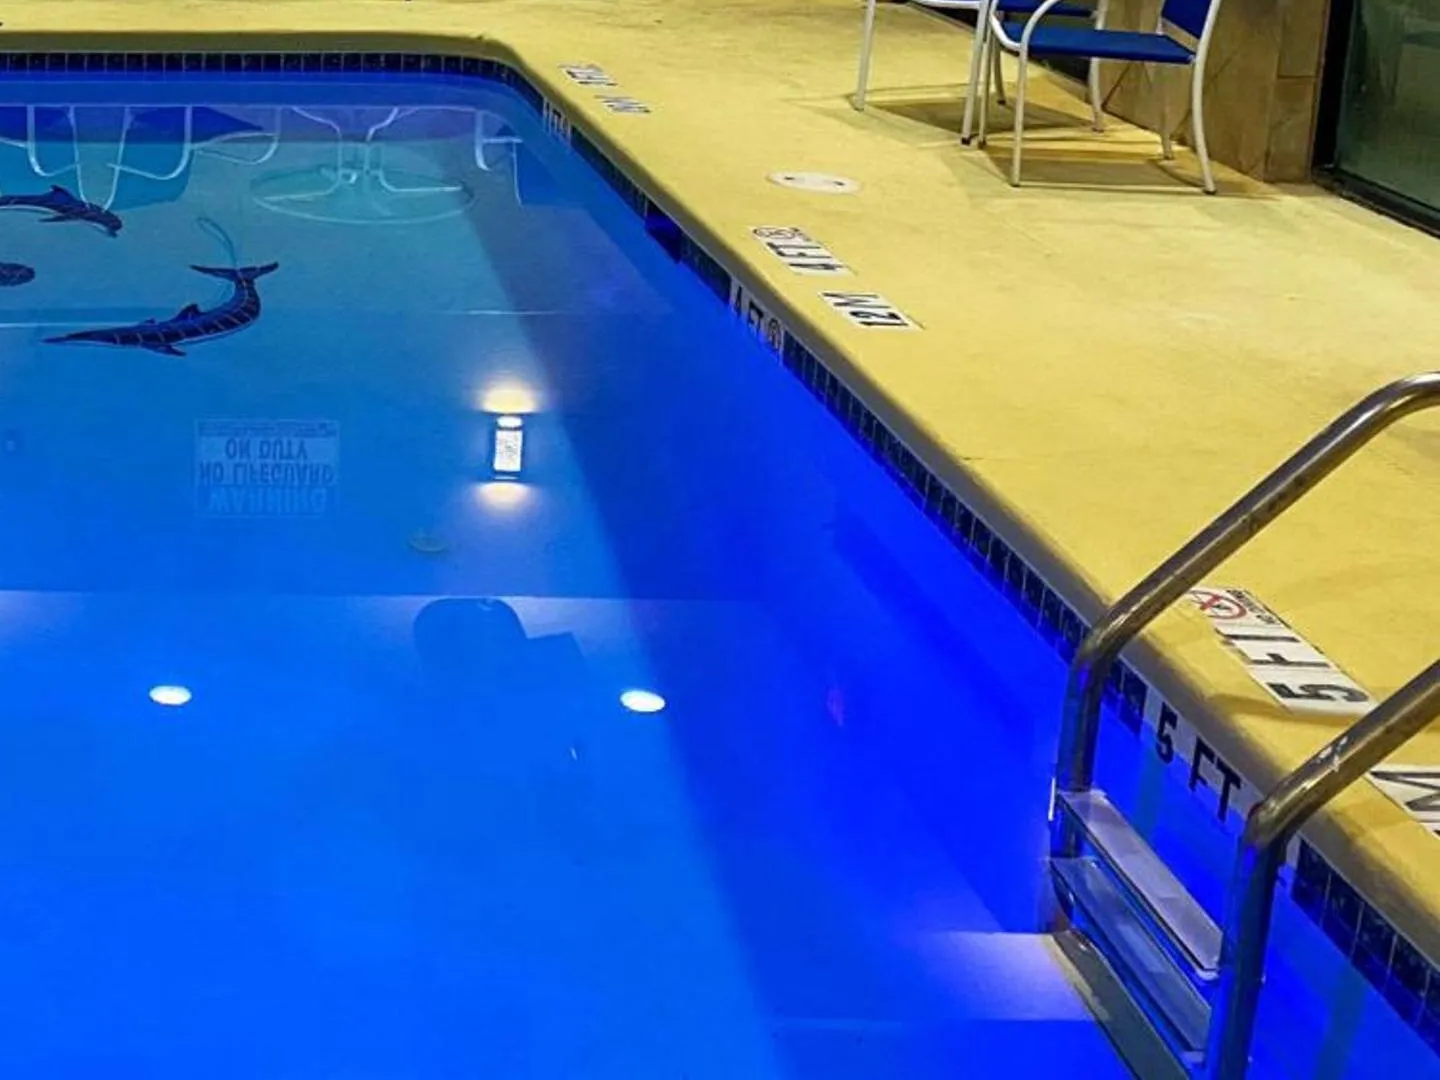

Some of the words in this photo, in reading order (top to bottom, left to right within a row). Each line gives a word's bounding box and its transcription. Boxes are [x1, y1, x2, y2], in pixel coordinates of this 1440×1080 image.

[1266, 682, 1370, 704] 5
[1156, 701, 1178, 765] 5
[1188, 737, 1241, 824] FT
